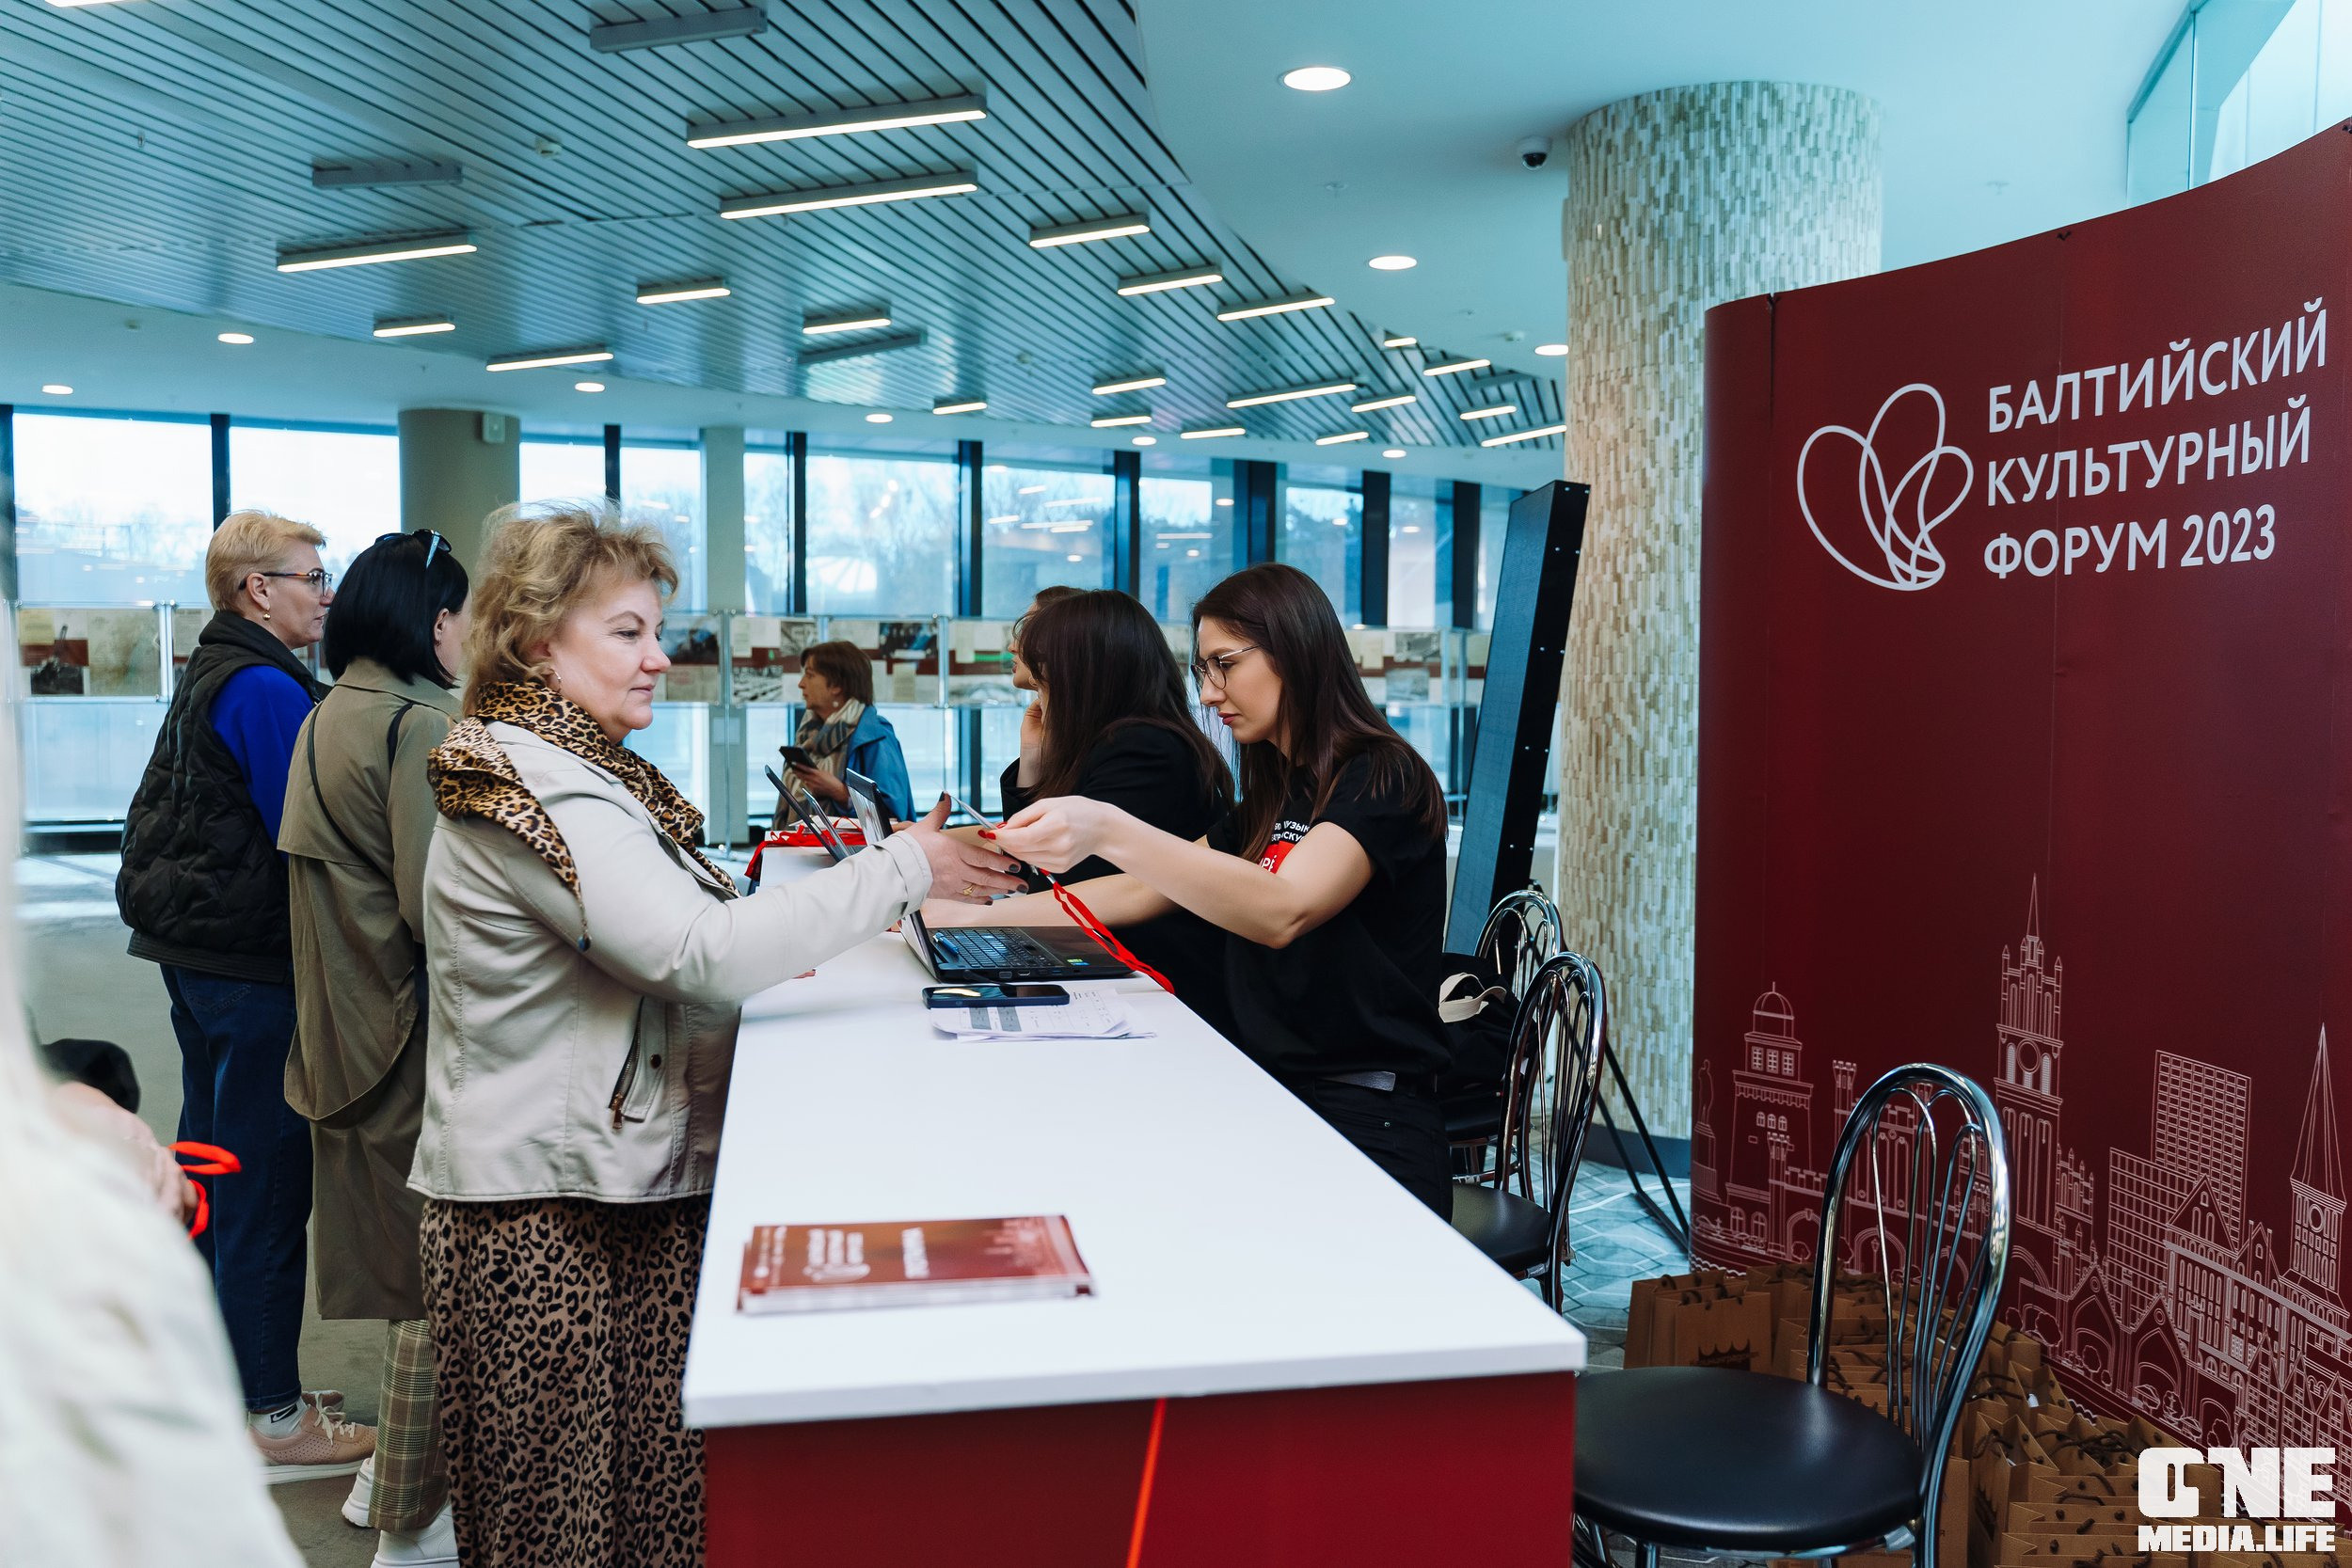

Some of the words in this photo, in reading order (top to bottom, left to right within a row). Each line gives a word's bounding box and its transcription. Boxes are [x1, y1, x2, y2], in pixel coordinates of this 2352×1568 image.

[1989, 296, 2328, 434] БАЛТИЙСКИЙ
[1987, 394, 2312, 507] КУЛЬТУРНЫЙ
[1983, 518, 2168, 579] ФОРУМ
[2180, 503, 2276, 568] 2023
